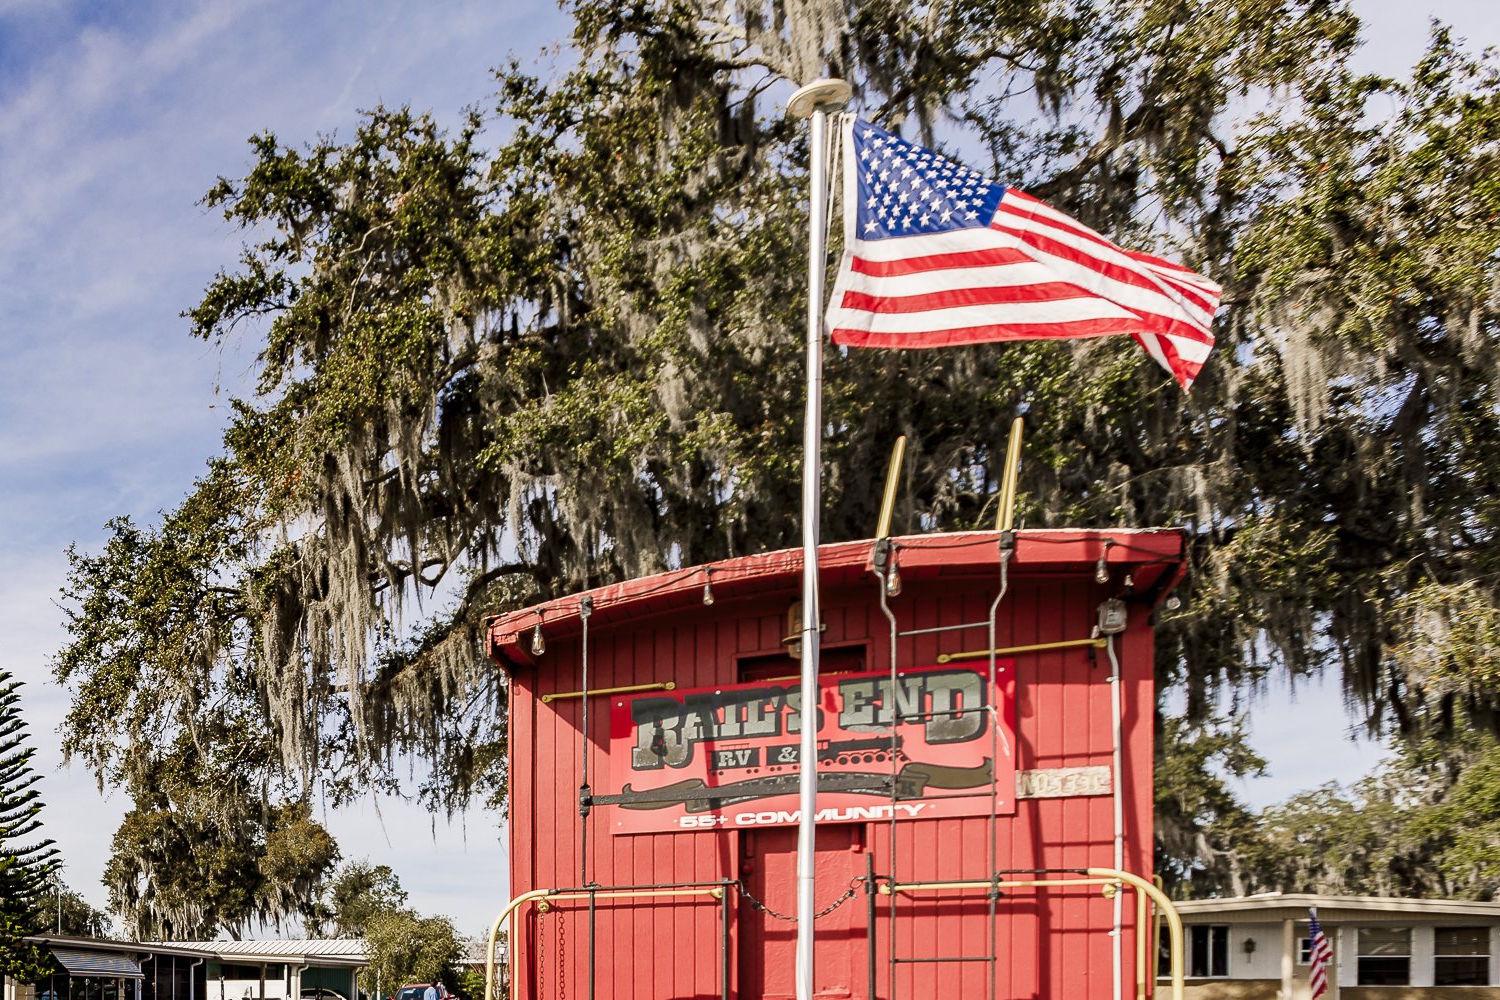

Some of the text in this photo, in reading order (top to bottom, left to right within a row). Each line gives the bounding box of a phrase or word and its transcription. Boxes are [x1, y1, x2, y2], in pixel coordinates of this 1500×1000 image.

[838, 669, 988, 744] END
[718, 747, 799, 767] RV &
[679, 803, 927, 827] 55+ COMMUNITY
